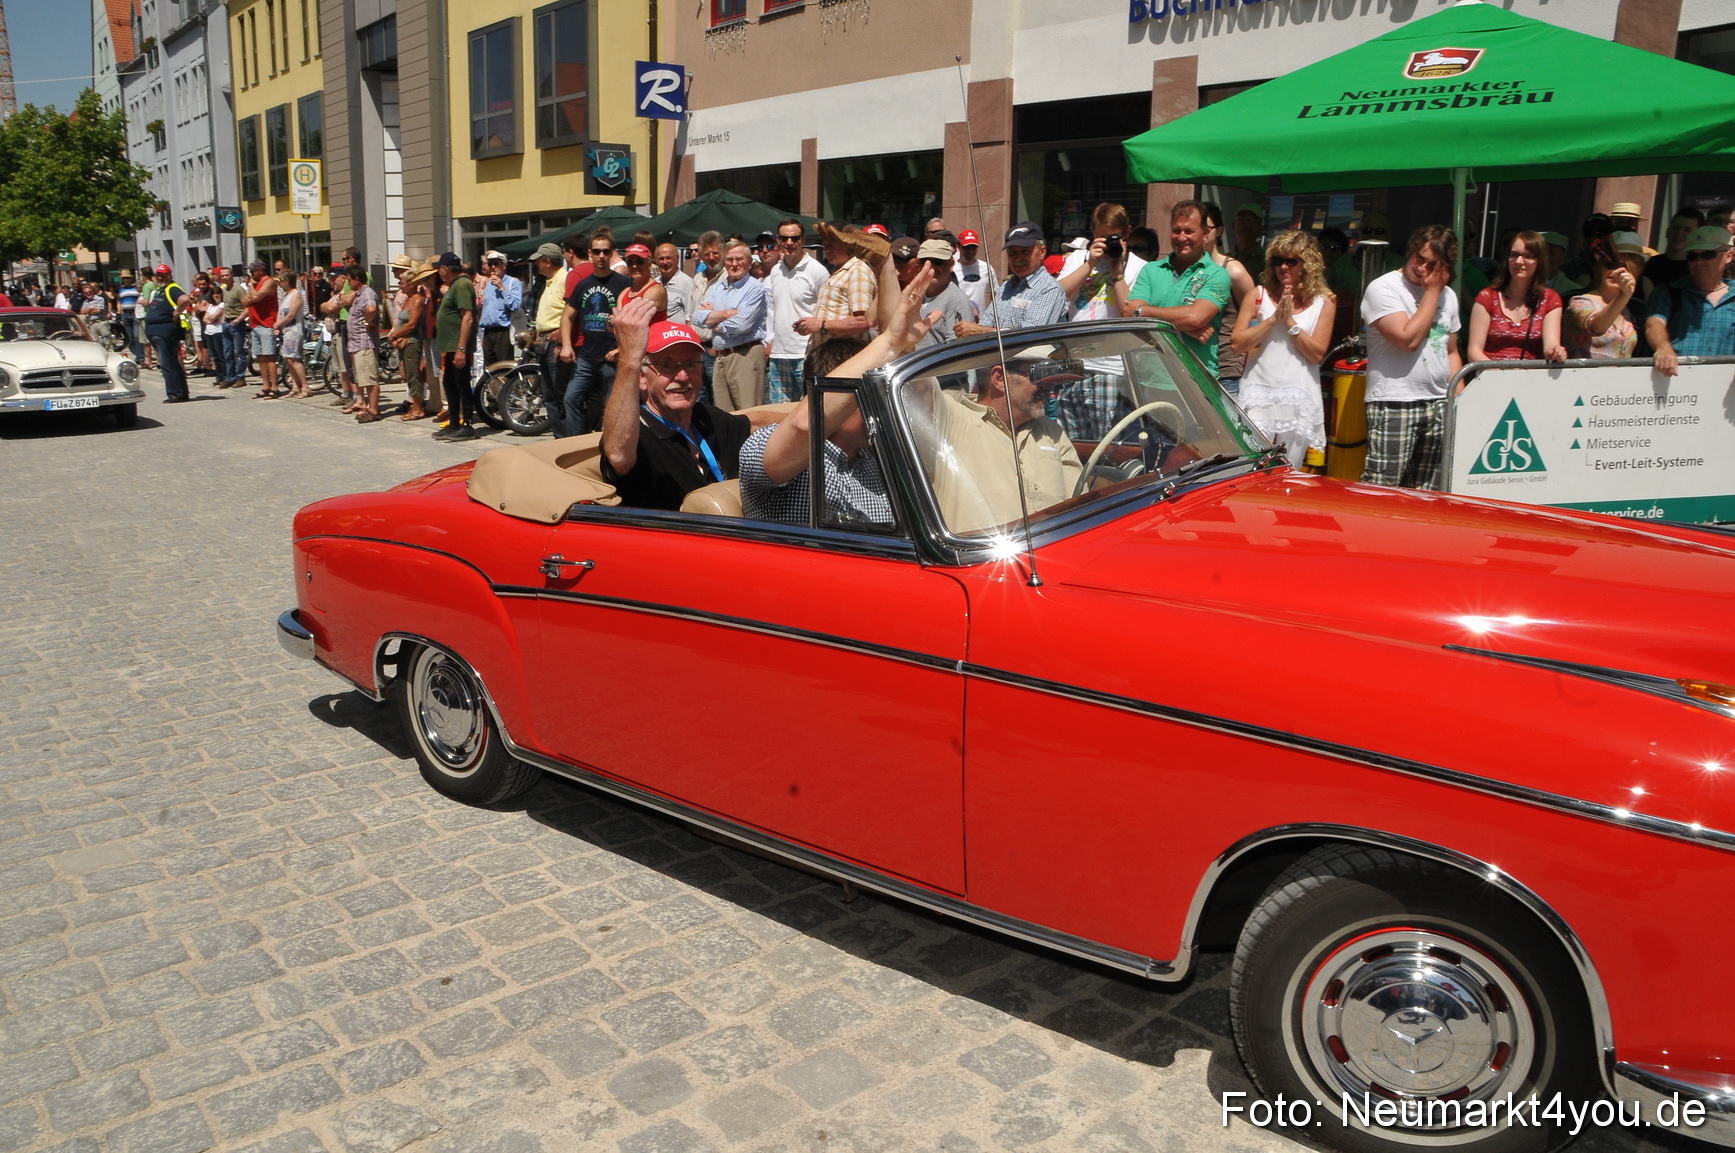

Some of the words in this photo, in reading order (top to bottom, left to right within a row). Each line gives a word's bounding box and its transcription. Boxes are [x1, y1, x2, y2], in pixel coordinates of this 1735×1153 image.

[1339, 81, 1526, 101] Neumarkter
[1297, 91, 1555, 119] Lammsbräu
[688, 137, 707, 147] Unterer
[708, 133, 722, 144] Markt
[724, 131, 730, 141] 15
[300, 168, 310, 181] H
[603, 157, 619, 179] G2
[581, 286, 616, 308] MILWAUKEE
[662, 329, 692, 339] DEKRA
[1590, 393, 1698, 407] Gebäudereinigung
[1588, 414, 1700, 428] Hausmeisterdienste
[1586, 437, 1651, 449] Mietservice
[1595, 457, 1704, 470] Event-Leit-Systeme
[1480, 477, 1506, 485] Gebäude
